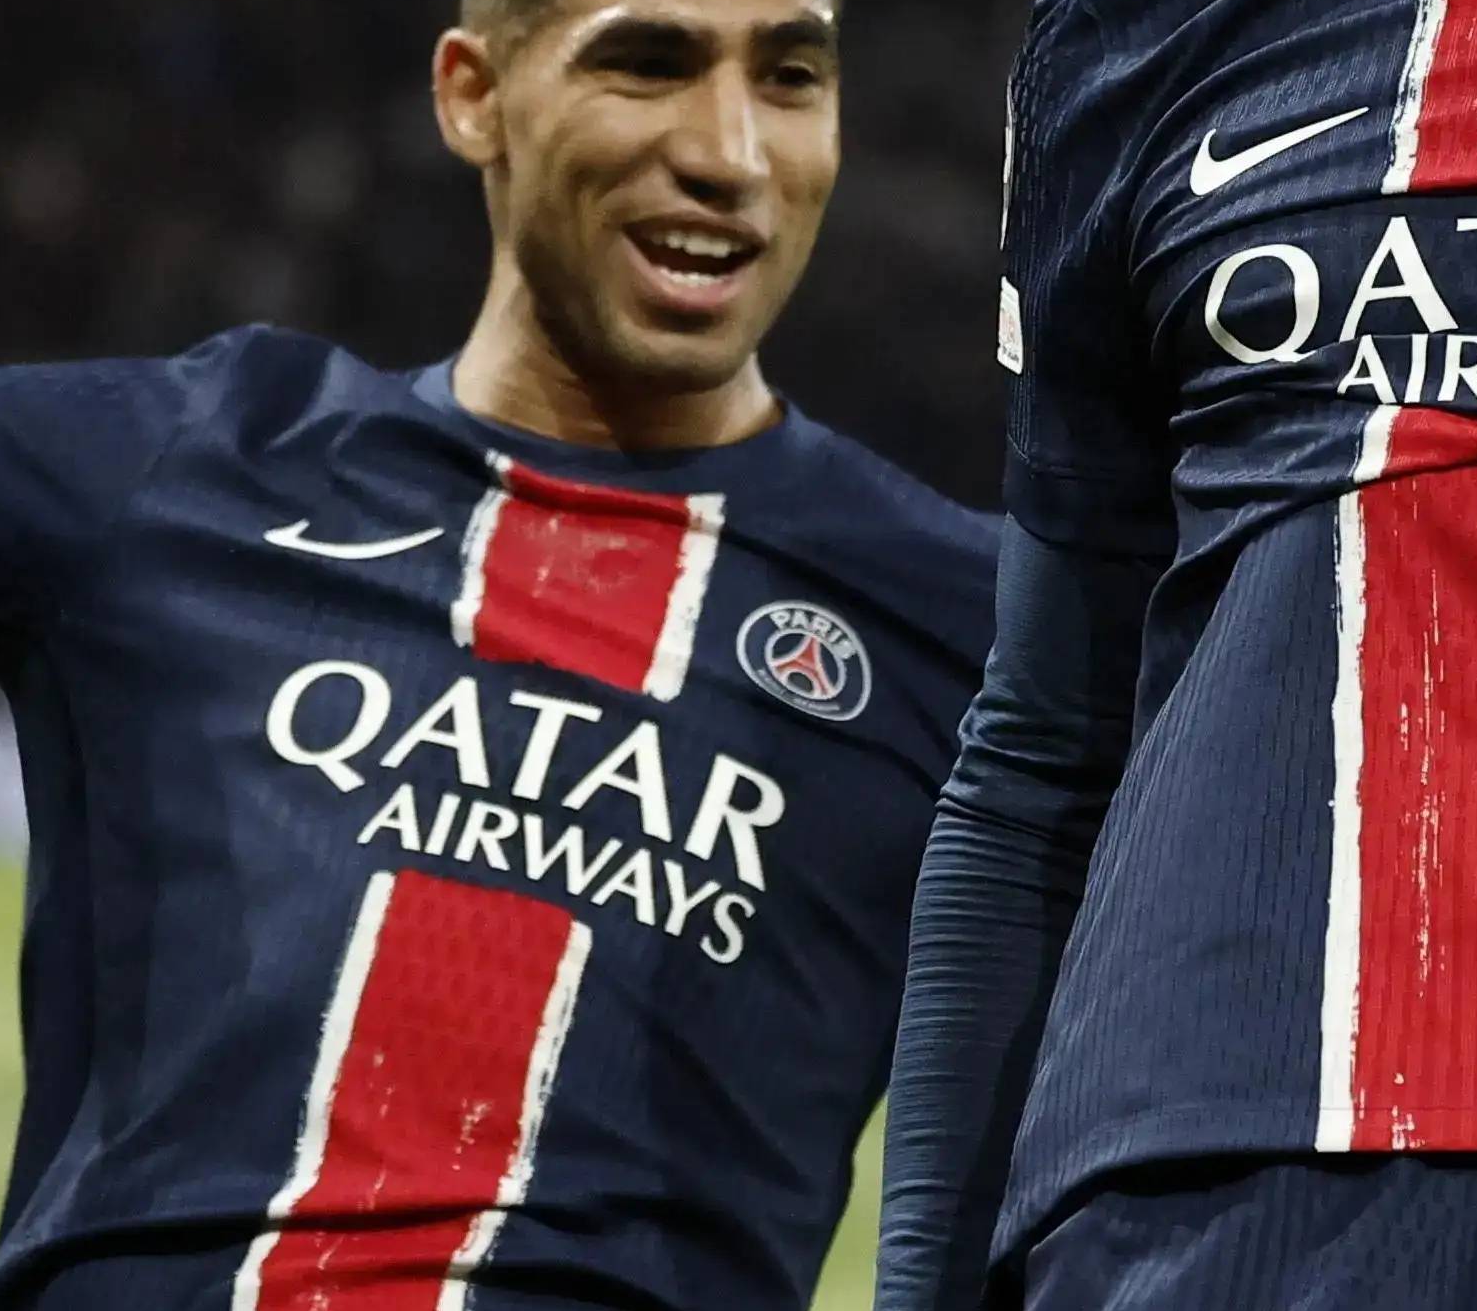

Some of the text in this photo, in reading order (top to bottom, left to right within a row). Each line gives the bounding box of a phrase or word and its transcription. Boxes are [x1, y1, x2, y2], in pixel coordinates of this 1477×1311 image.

[770, 610, 857, 660] PARIS
[266, 660, 786, 891] QATAR
[358, 783, 756, 964] AIRWAYS
